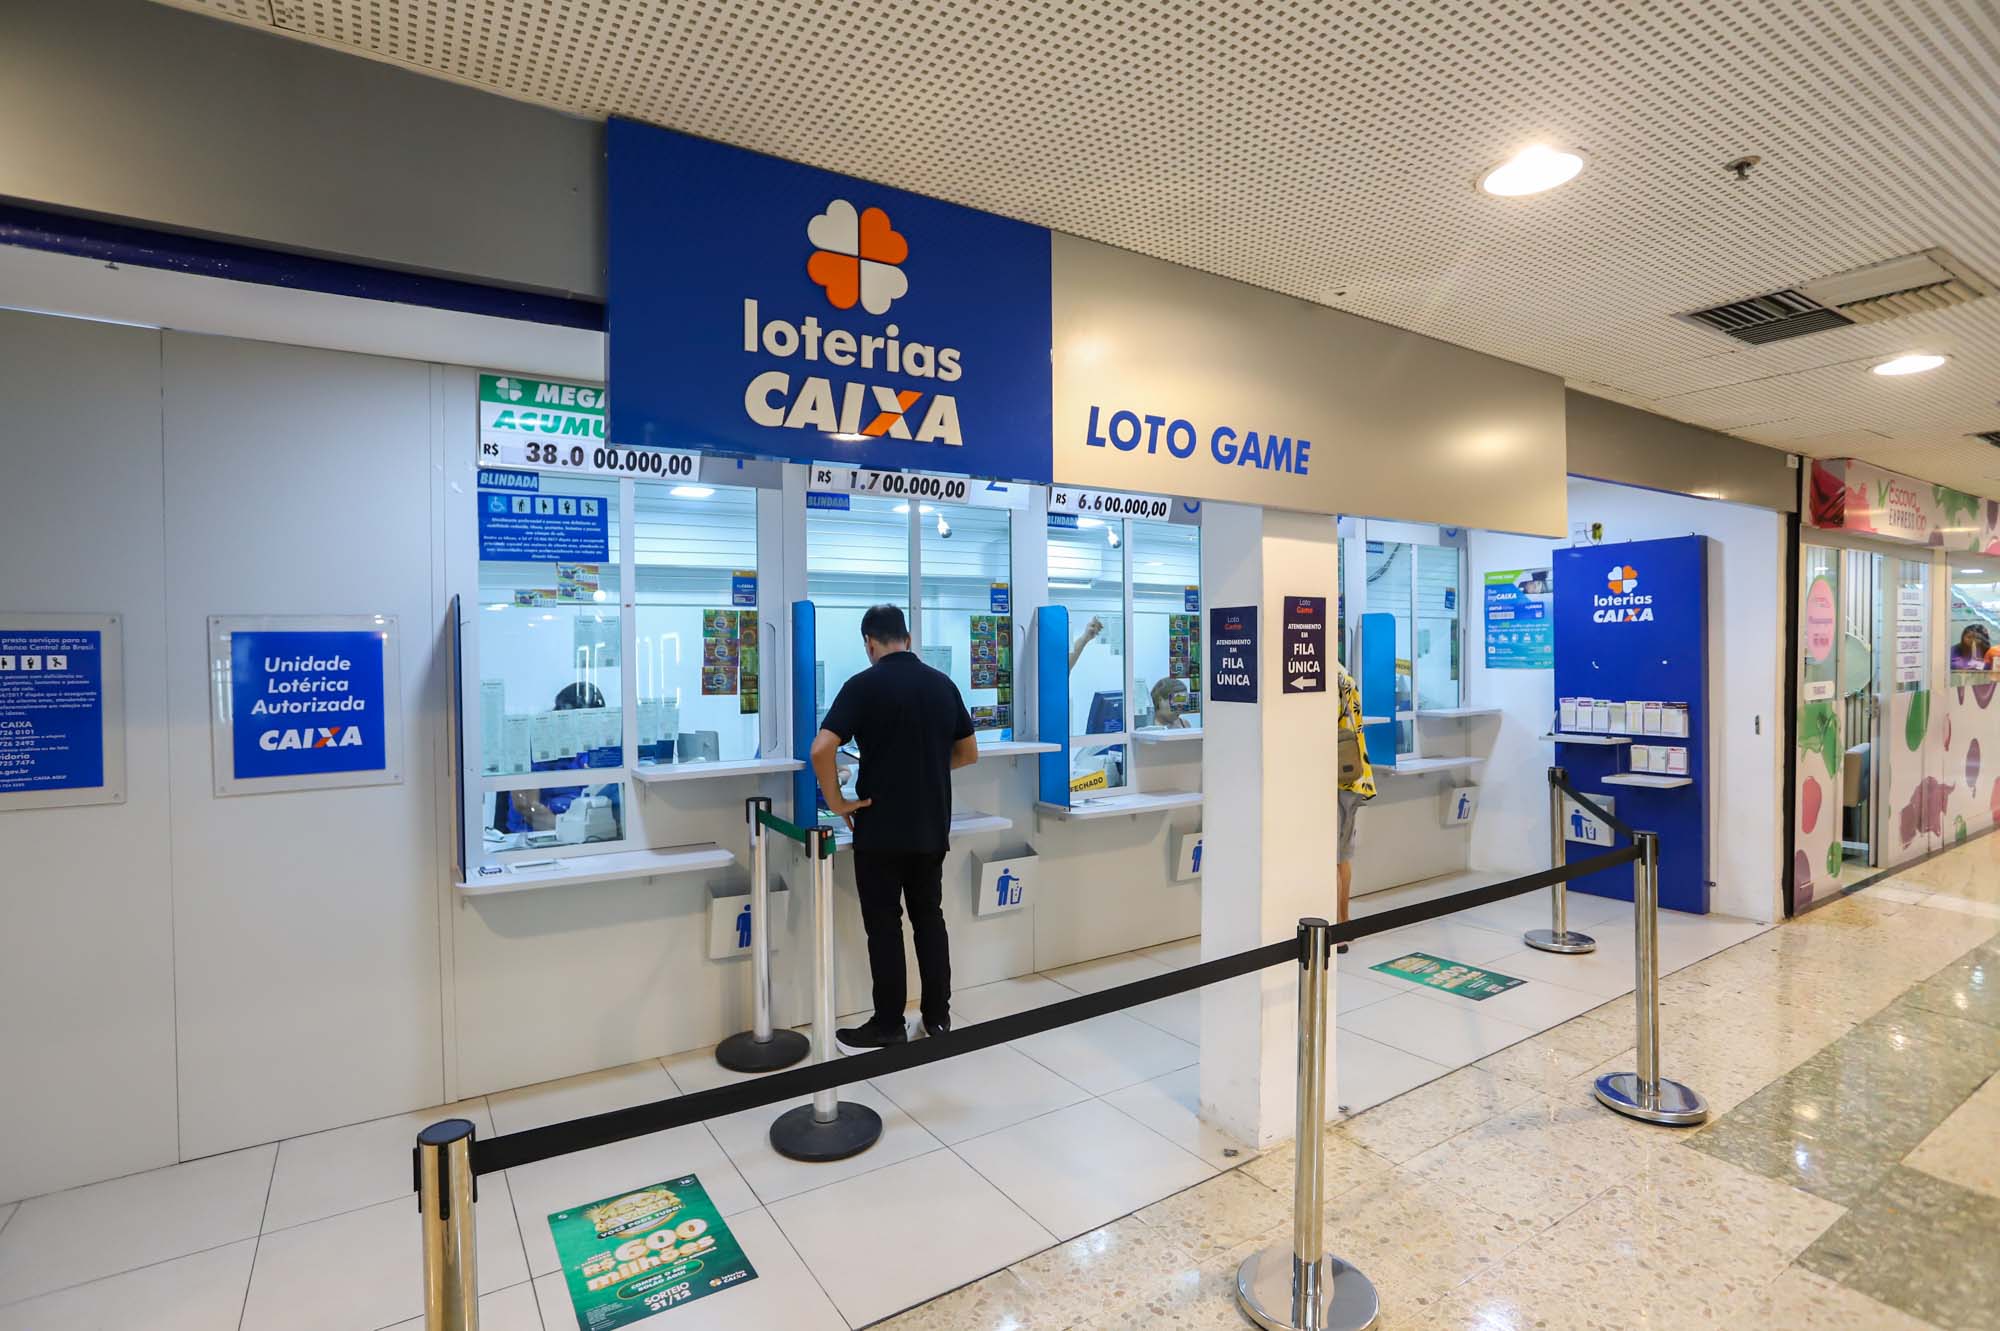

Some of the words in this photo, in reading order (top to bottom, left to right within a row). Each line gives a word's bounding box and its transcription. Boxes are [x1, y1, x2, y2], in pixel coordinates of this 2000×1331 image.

[744, 298, 962, 383] loterias
[744, 371, 963, 446] CAIXA
[1087, 405, 1197, 459] LOTO
[1211, 426, 1311, 475] GAME
[483, 443, 499, 457] R$
[480, 472, 538, 488] BLINDADA
[817, 470, 832, 485] R$
[850, 471, 965, 500] 1.700.000,00
[1055, 493, 1067, 505] R$
[1078, 494, 1167, 518] 6.600.000,00
[1593, 594, 1652, 607] loterias
[1593, 608, 1654, 623] CAIXA
[1294, 643, 1315, 655] FILA
[264, 656, 351, 673] Unidade
[1222, 657, 1244, 669] FILA
[1288, 658, 1320, 673] ÚNICA
[268, 677, 349, 694] Lotérica
[1217, 671, 1250, 686] ÚNICA
[251, 696, 365, 715] Autorizada
[259, 725, 363, 751] CAIXA
[1070, 776, 1103, 792] FECHADO
[614, 1218, 708, 1261] 600
[586, 1235, 716, 1291] milhões
[643, 1281, 690, 1306] SORTEIO
[650, 1289, 692, 1312] 31/12
